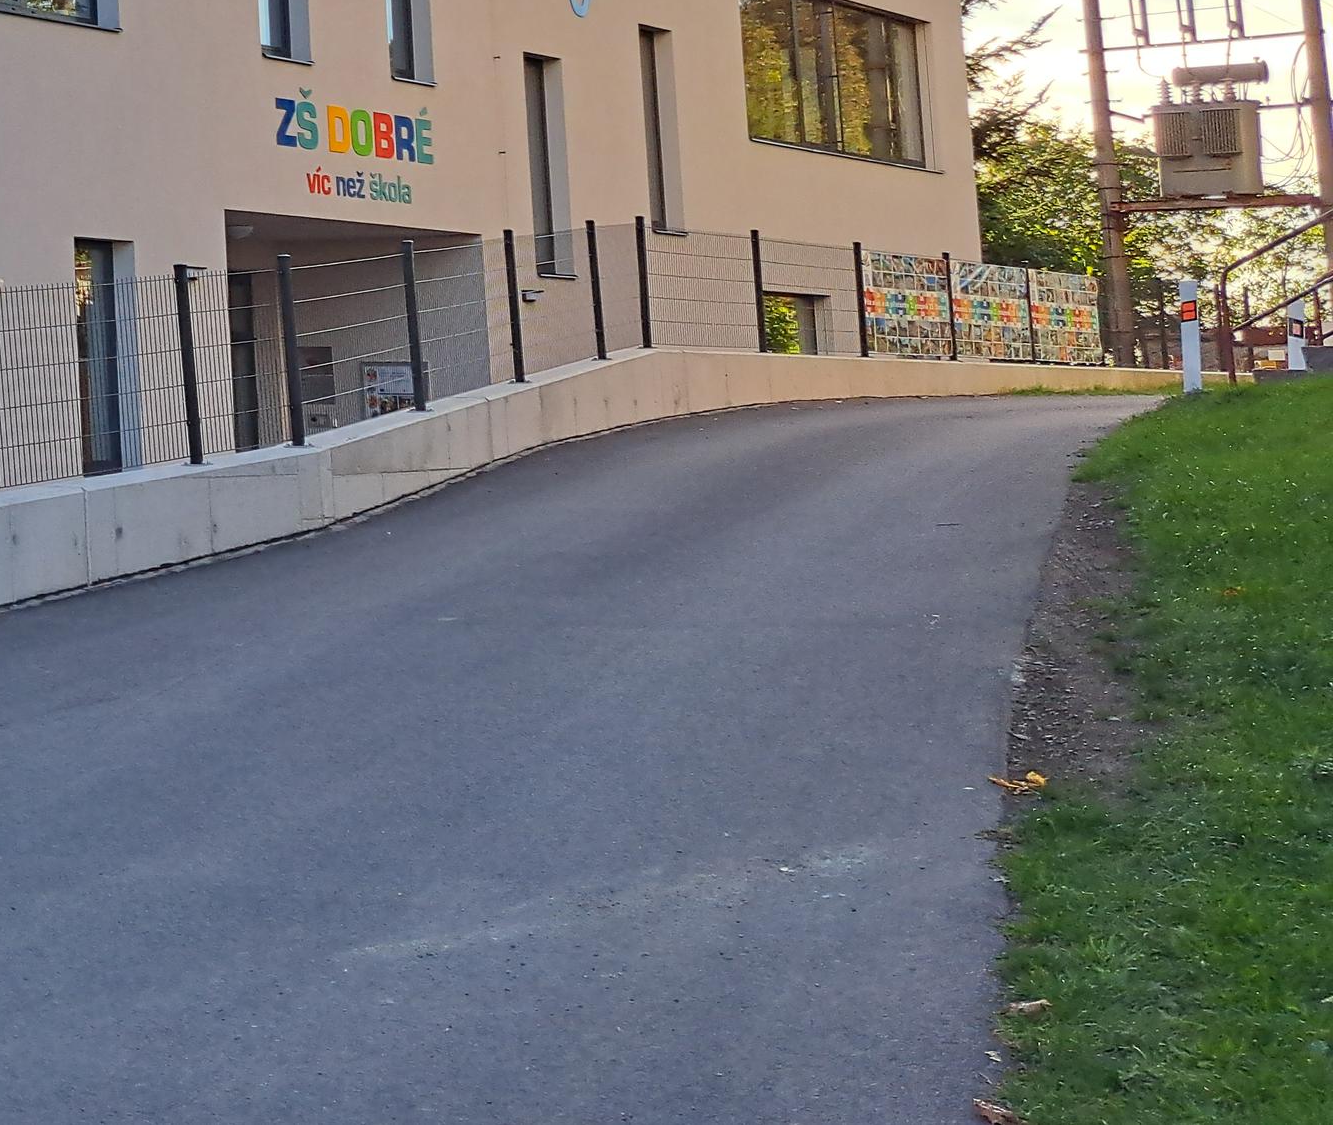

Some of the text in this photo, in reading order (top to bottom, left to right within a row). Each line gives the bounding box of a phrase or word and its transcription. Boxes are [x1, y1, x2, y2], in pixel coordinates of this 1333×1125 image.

[275, 87, 434, 165] ZŠ DOBRÉ
[306, 166, 412, 204] víc než škola
